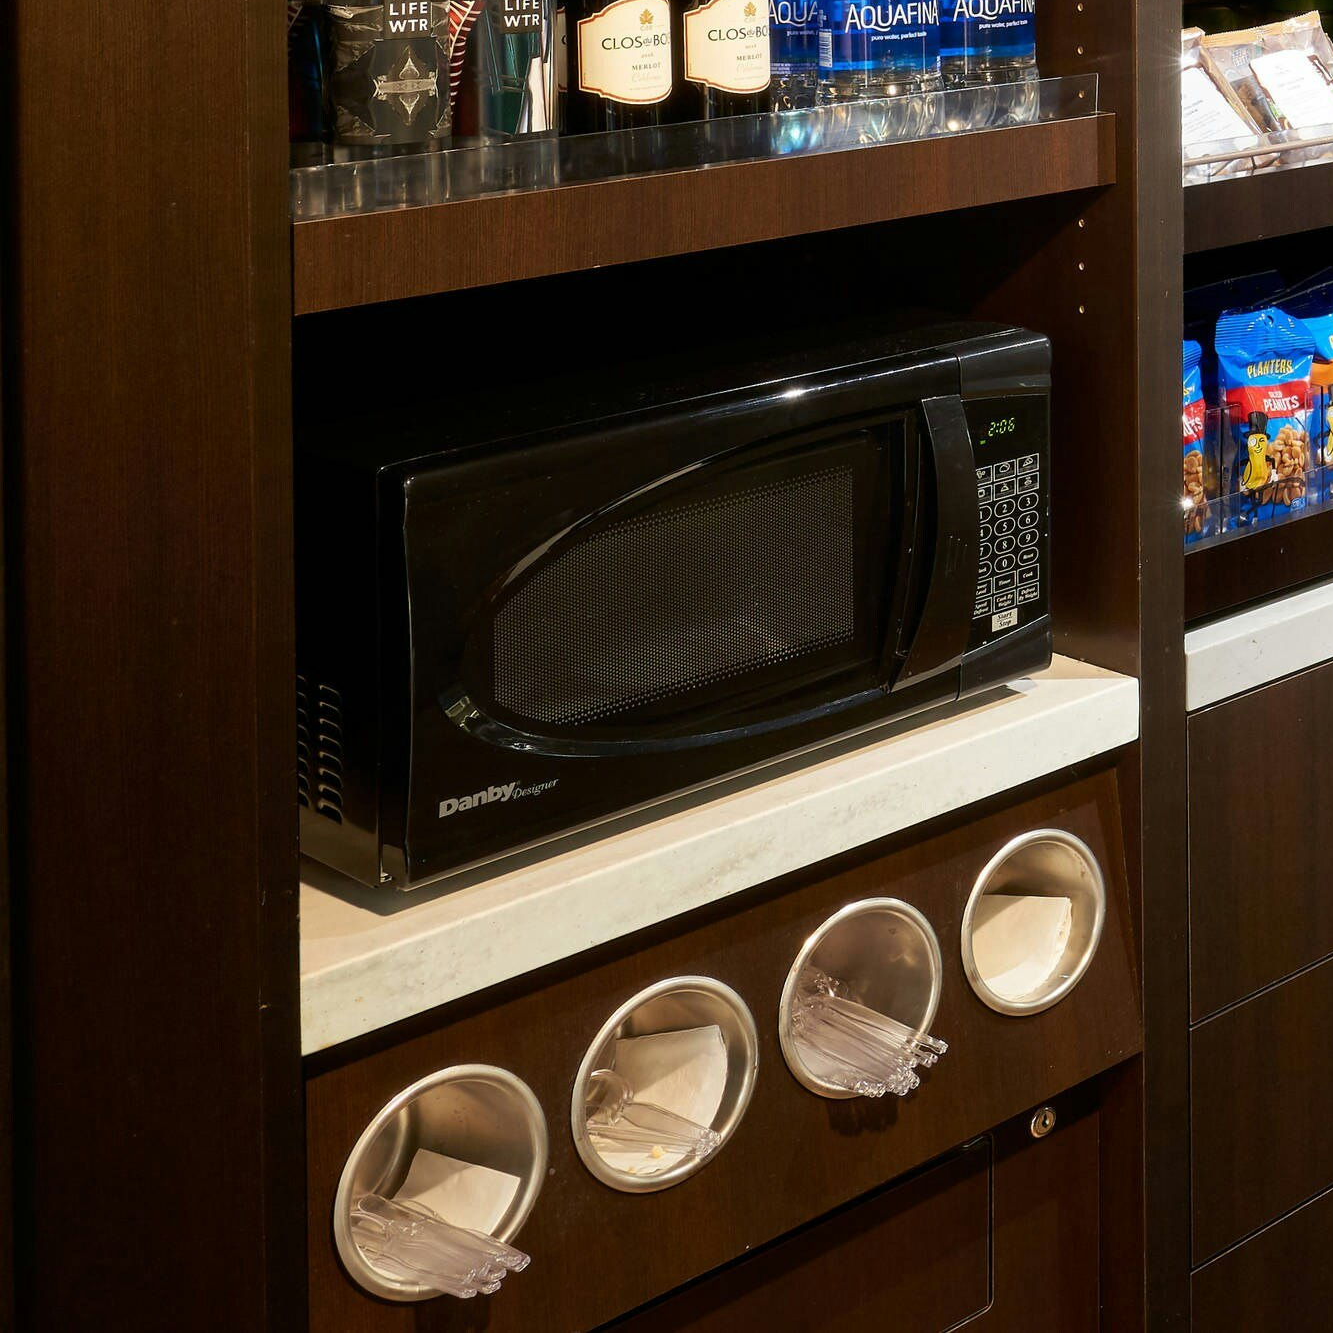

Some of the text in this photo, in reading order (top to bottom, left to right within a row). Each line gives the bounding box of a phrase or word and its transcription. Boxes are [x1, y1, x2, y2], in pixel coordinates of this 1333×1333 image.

[389, 1, 428, 16] LIFE
[389, 18, 428, 33] WTR
[504, 13, 540, 28] WTR
[707, 27, 747, 42] CLOS
[601, 36, 643, 51] CLOS
[736, 52, 763, 61] MERLOT
[631, 62, 662, 71] MERLOT
[1247, 358, 1293, 380] PLANTERS
[1263, 396, 1300, 413] PEANUTS
[439, 778, 559, 818] Danby Designer
